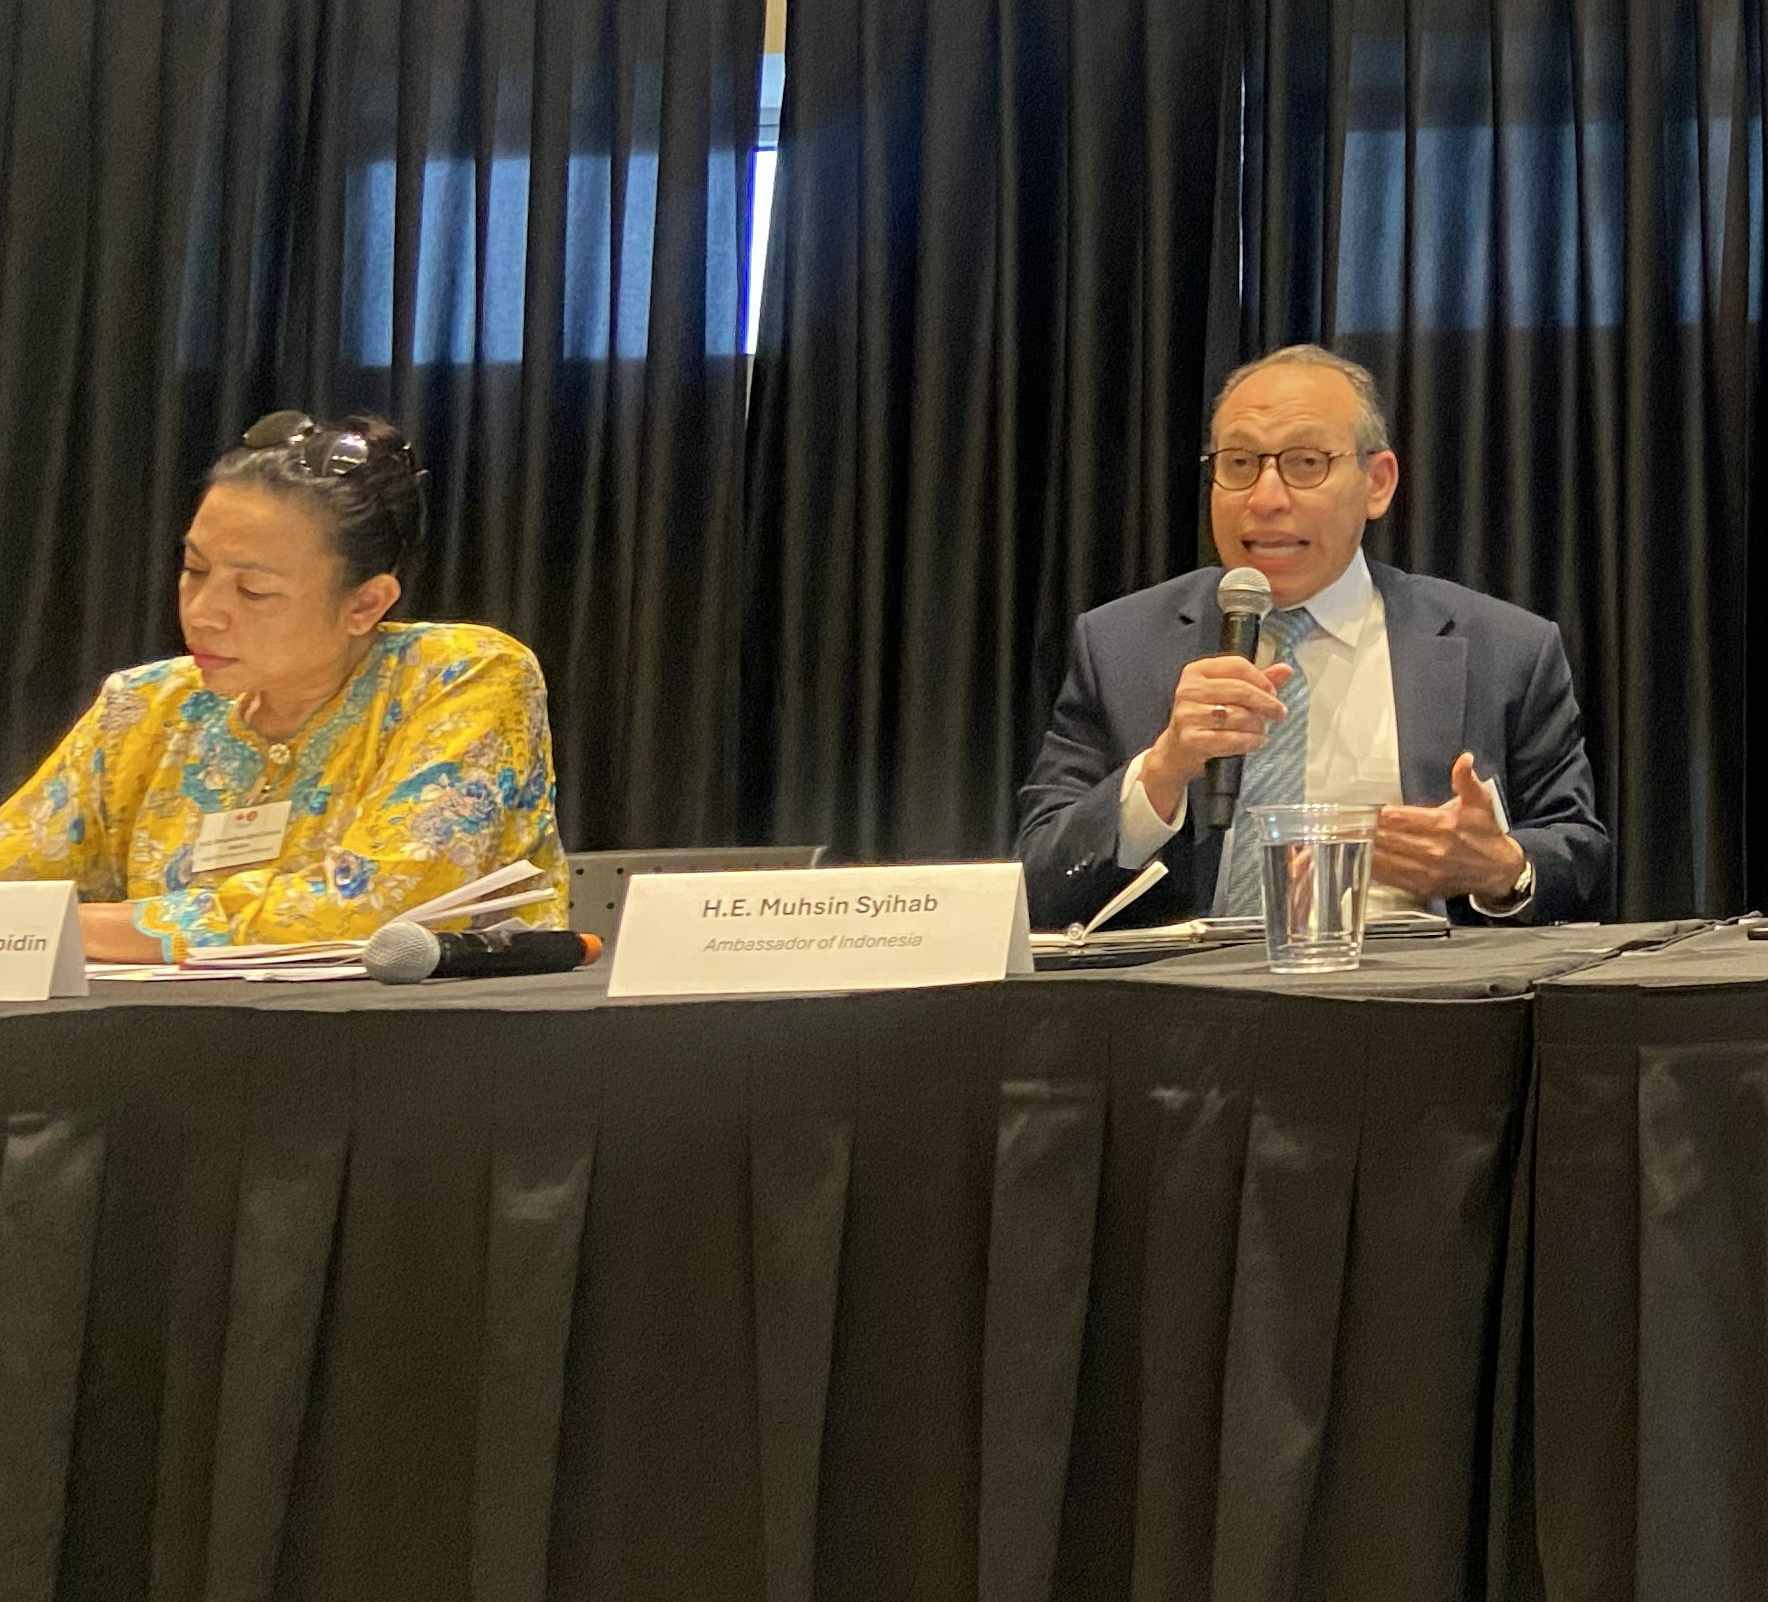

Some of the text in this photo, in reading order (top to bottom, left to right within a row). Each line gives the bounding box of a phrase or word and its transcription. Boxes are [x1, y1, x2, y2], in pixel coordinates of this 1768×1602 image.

[703, 894, 938, 918] H.E. Muhsin Syihab
[704, 932, 923, 952] Ambassador of Indonesia
